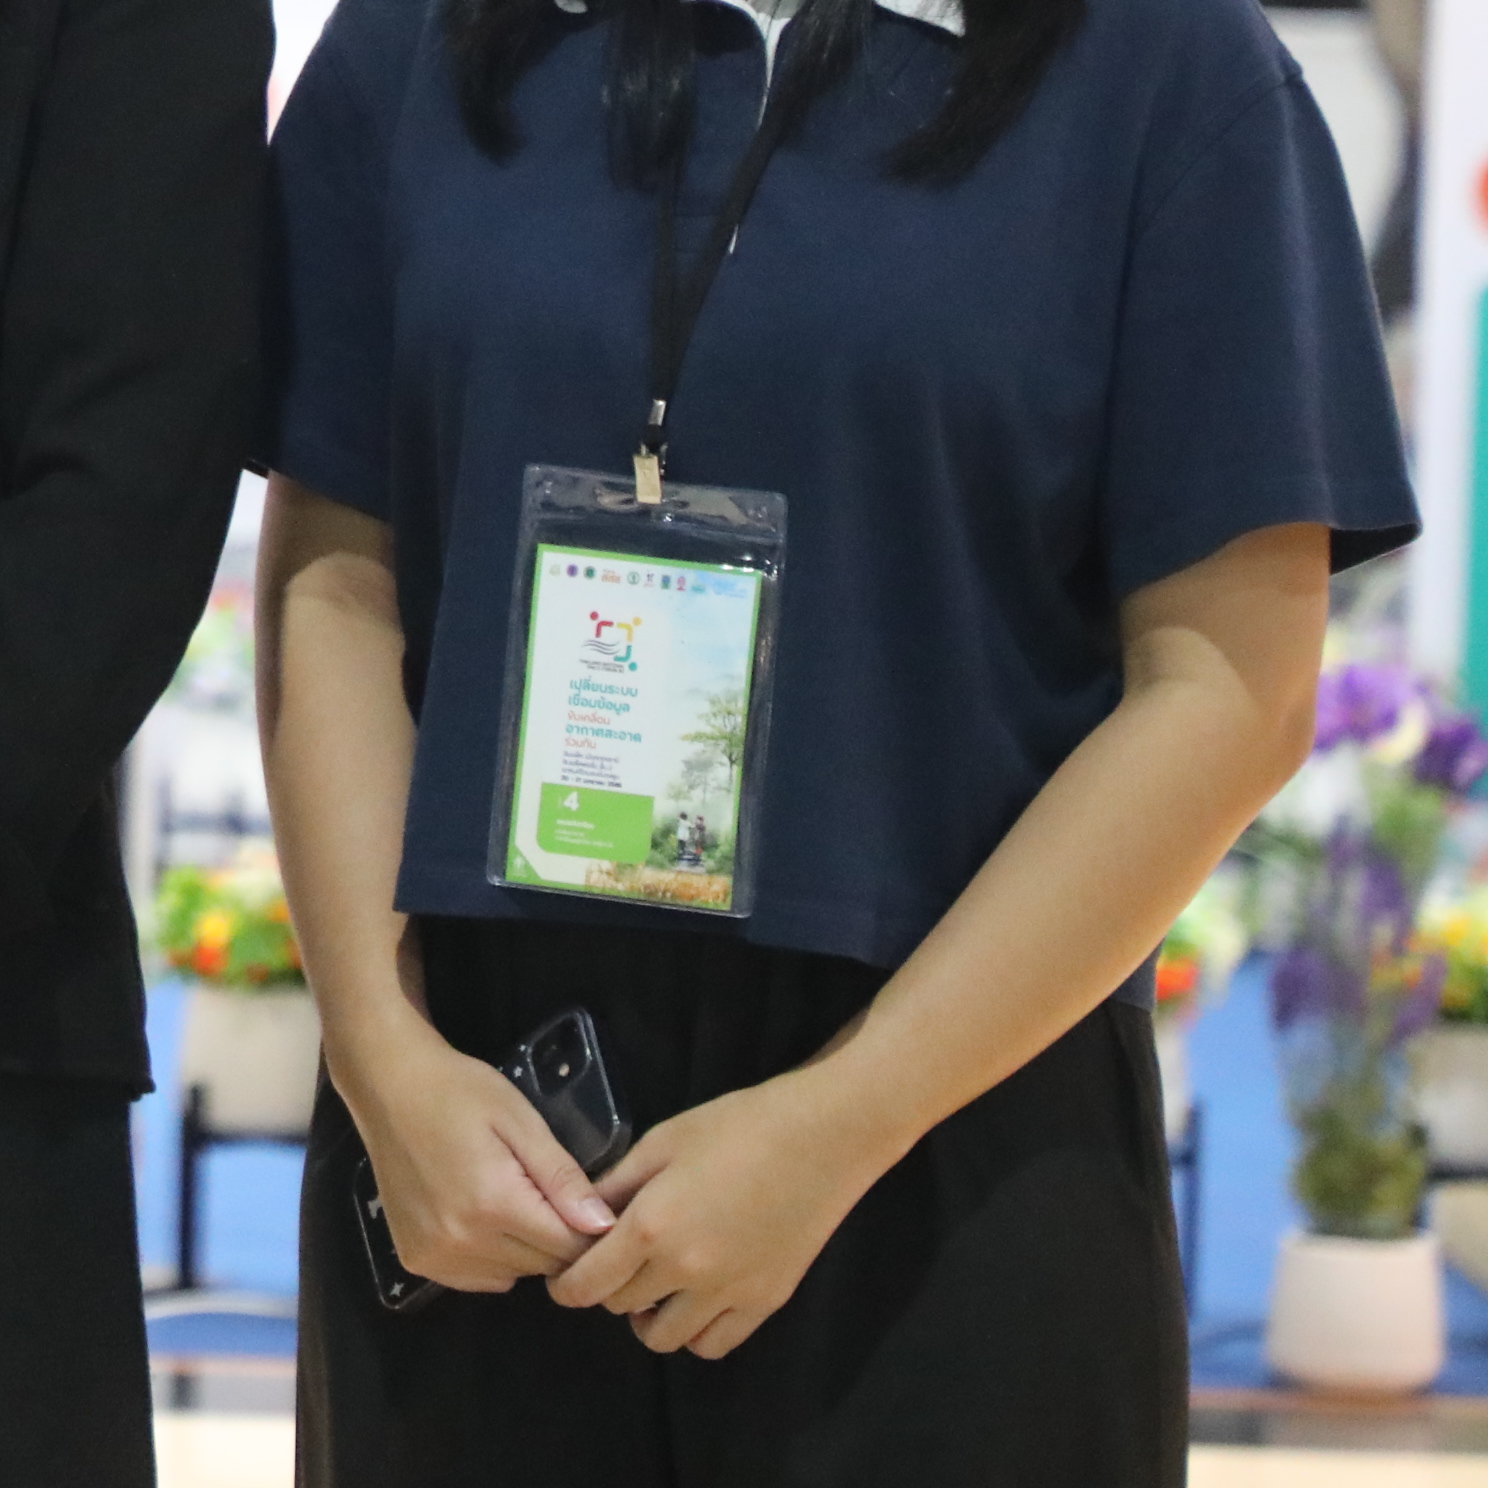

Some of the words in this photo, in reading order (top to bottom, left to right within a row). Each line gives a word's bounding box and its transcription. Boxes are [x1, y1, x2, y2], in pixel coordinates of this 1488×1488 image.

[569, 676, 638, 697] เปลี่ยนระบบ
[568, 693, 630, 715] เชื่อมข้อมูล
[566, 724, 642, 742] อากาศสะอาด
[563, 791, 579, 811] 4
